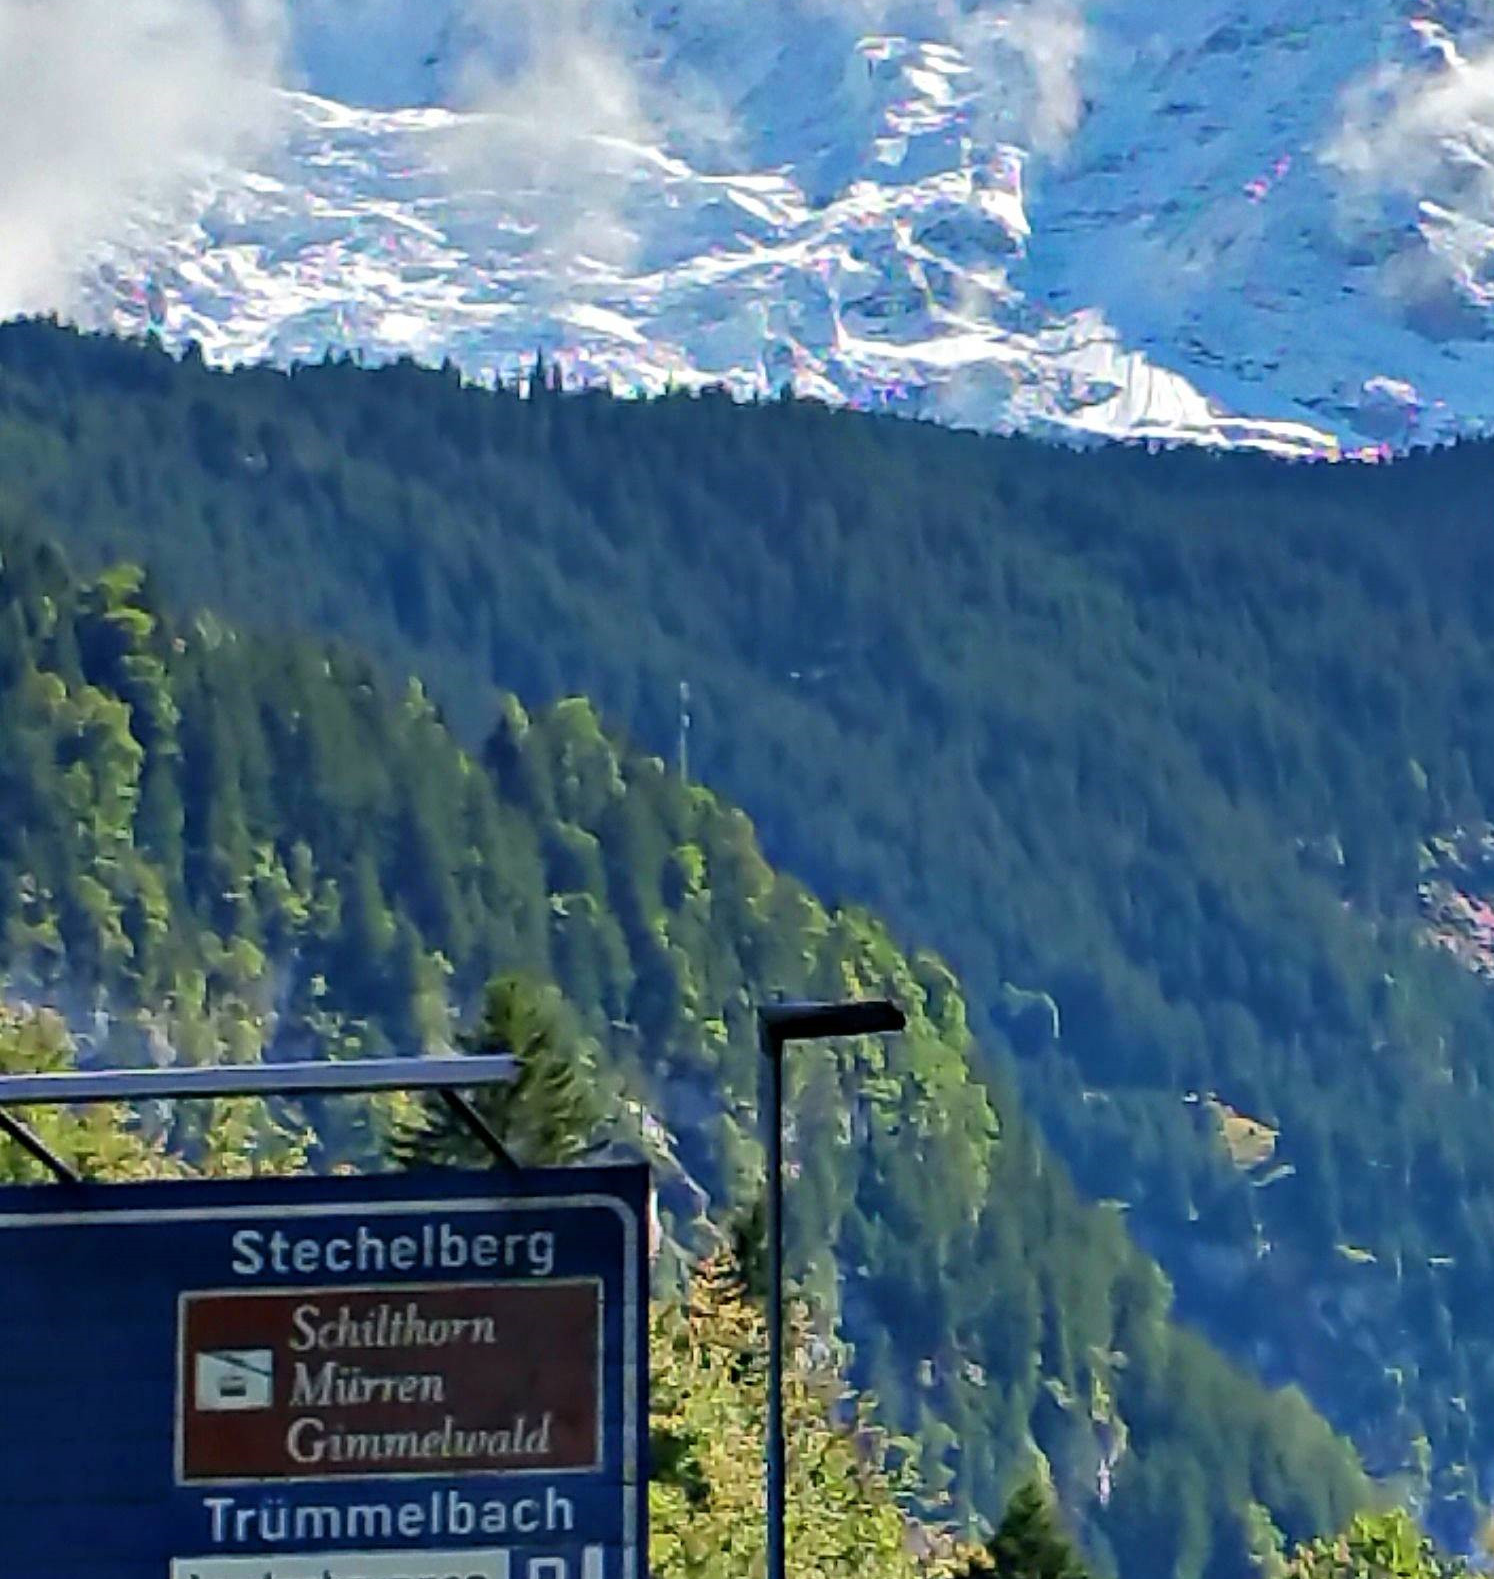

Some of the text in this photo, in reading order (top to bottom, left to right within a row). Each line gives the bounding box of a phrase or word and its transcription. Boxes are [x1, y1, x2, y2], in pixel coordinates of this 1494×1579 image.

[231, 1223, 556, 1275] Stechelberg
[289, 1303, 497, 1351] Schilthorn
[289, 1362, 444, 1407] Mürren
[287, 1412, 552, 1463] Gimmelwald
[203, 1488, 574, 1542] Trümmelbach
